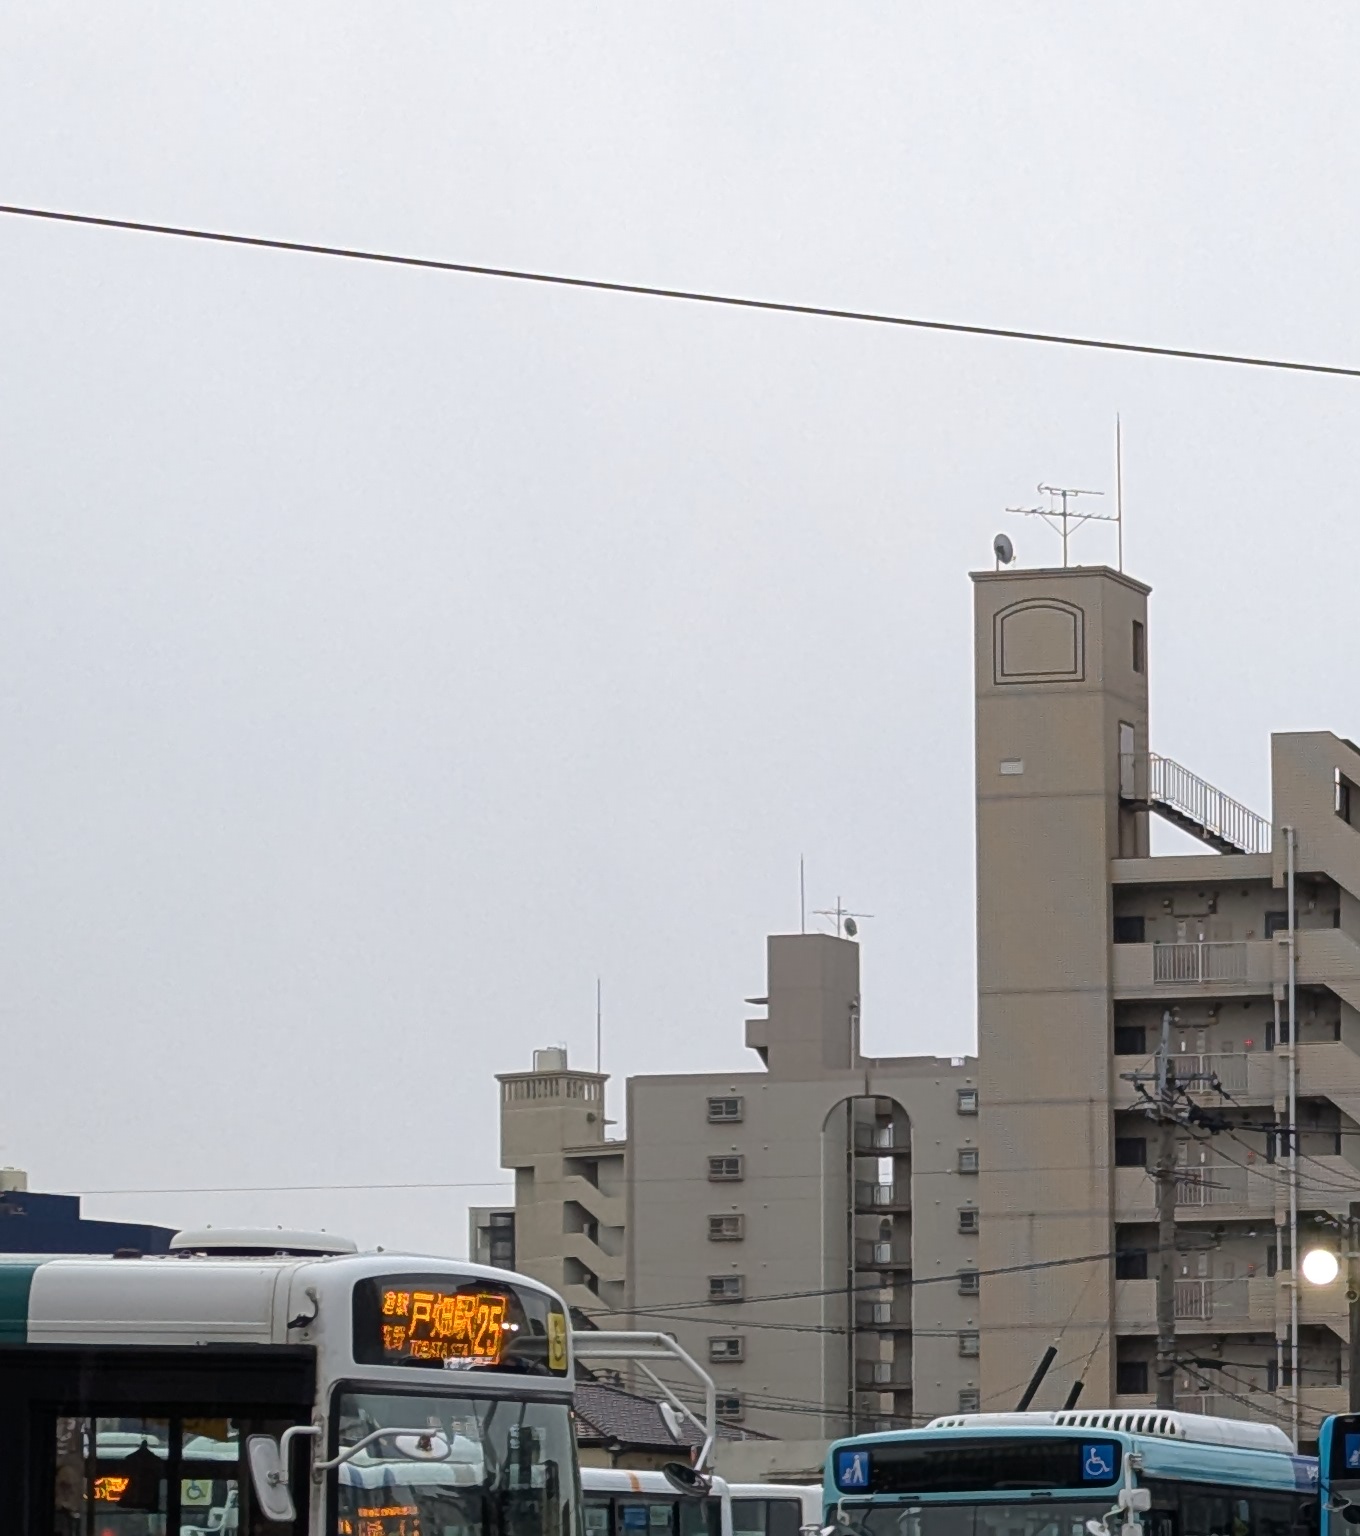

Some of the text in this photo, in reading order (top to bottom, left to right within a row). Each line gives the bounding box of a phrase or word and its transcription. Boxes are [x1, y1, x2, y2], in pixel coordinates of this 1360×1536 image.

[409, 1292, 477, 1339] 戸畑駅
[475, 1305, 503, 1355] 25
